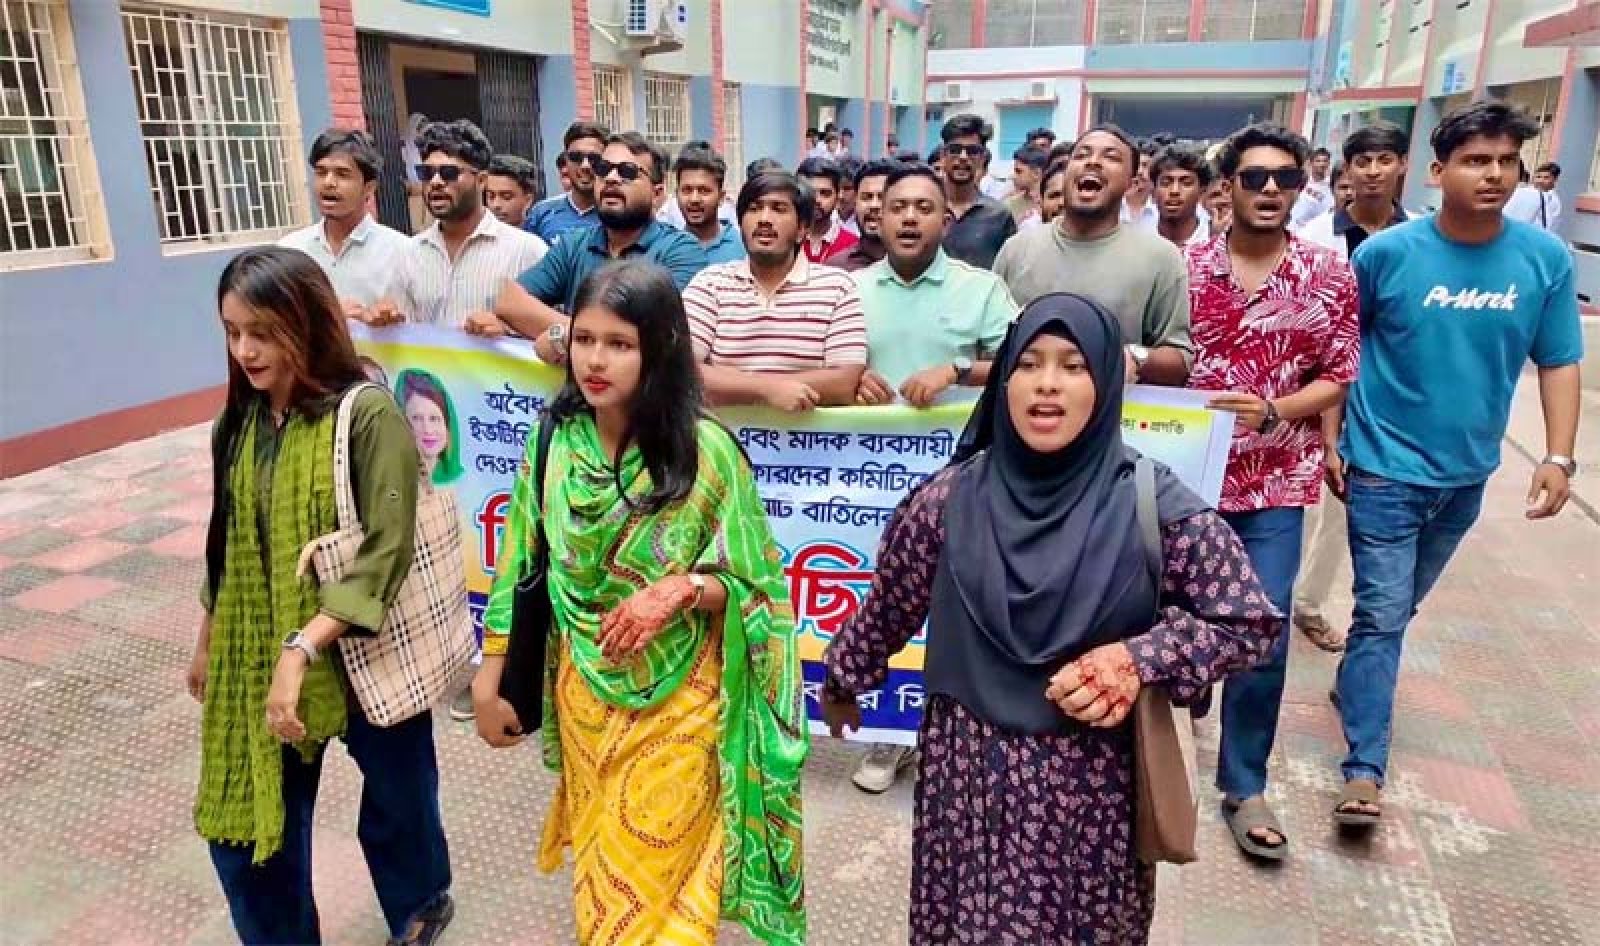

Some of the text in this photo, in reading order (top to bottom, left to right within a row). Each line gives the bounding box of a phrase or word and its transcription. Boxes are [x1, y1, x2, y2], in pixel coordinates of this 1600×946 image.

[738, 427, 781, 451] এবং
[787, 430, 852, 451] মাদক
[857, 429, 954, 458] ব্যবসায়ী
